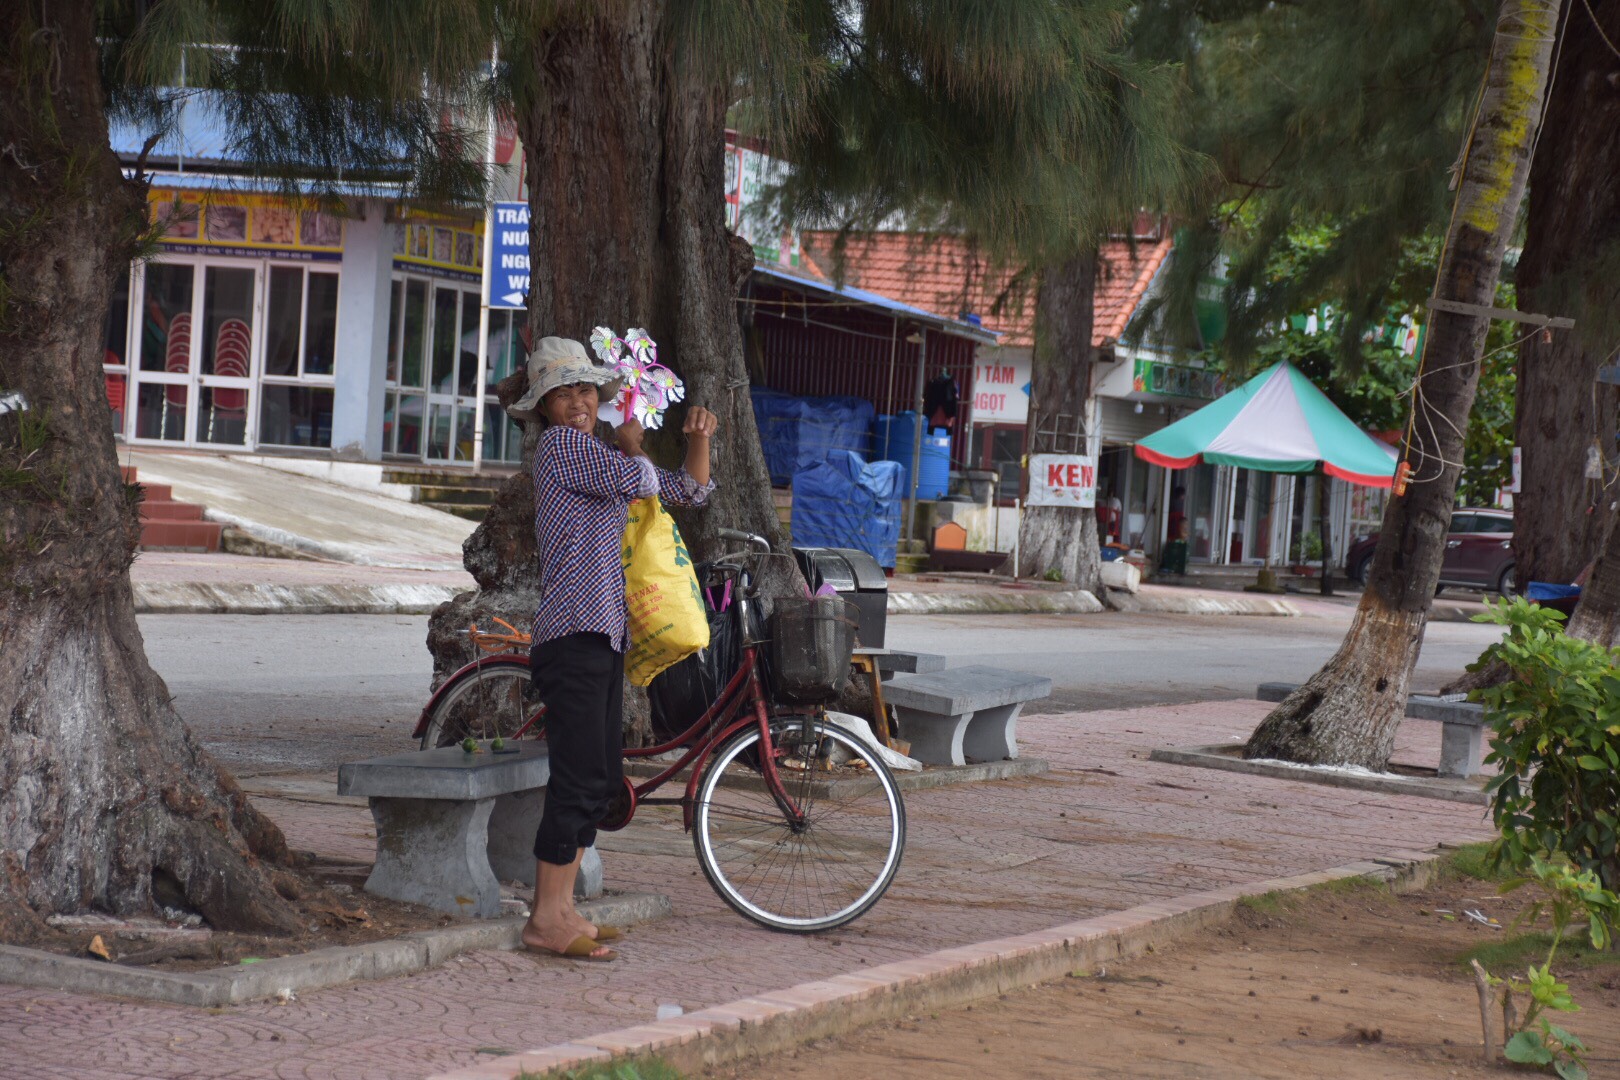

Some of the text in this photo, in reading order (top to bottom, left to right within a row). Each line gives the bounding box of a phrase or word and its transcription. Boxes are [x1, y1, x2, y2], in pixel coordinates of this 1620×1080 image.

[497, 207, 531, 224] TRÁ
[502, 254, 531, 271] NG
[985, 359, 1015, 384] TÂM
